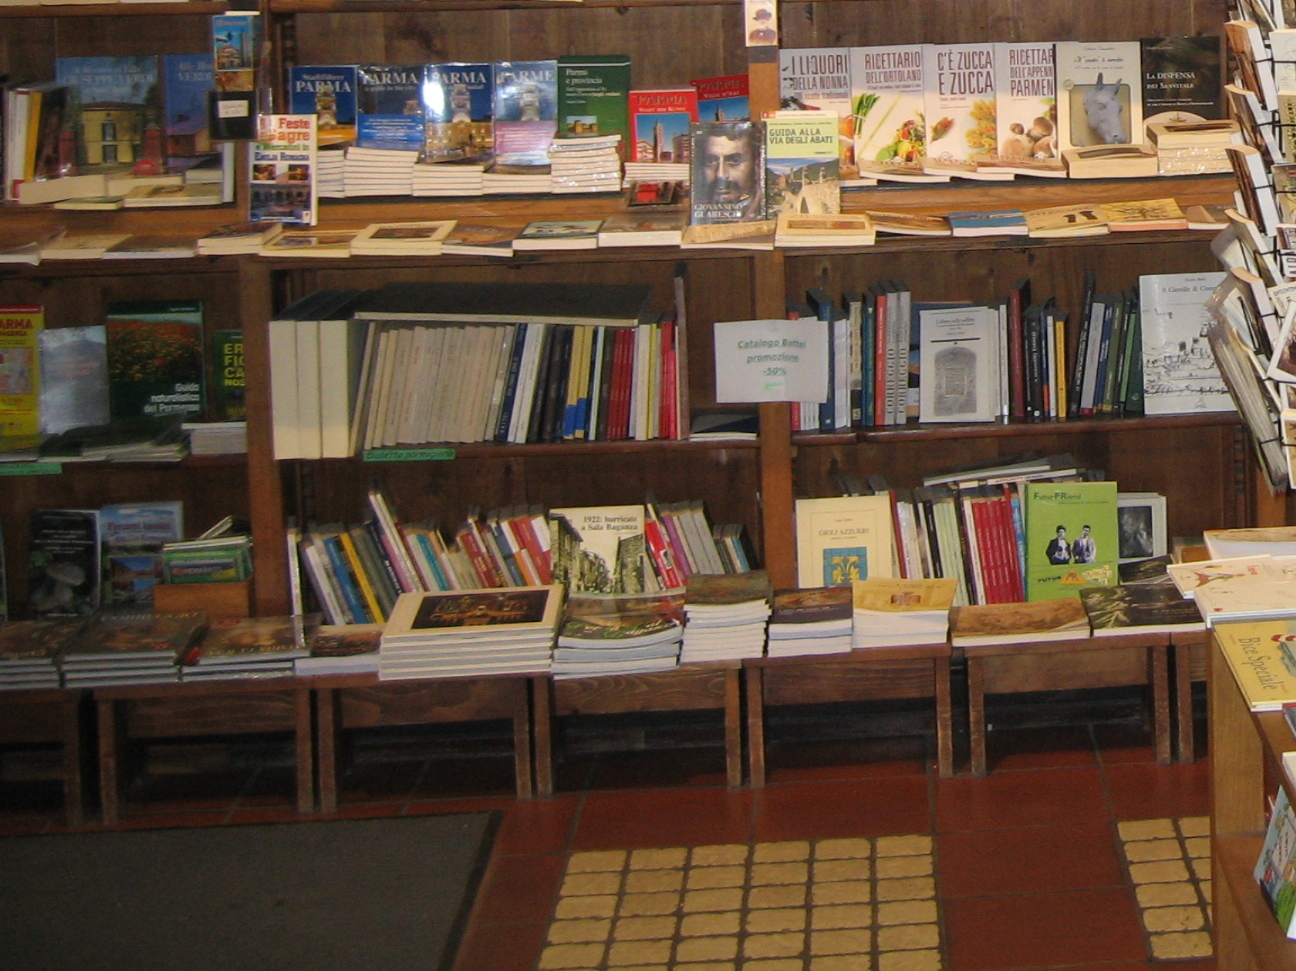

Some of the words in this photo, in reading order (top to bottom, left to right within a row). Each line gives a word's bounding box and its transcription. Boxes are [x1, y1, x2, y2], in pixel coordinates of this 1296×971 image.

[800, 55, 848, 75] LIQUORI
[865, 52, 921, 70] RICETTARIO
[958, 51, 993, 70] ZUCCA
[363, 72, 418, 84] PARMA
[866, 70, 921, 84] DELL'ORTOLANO
[1157, 72, 1196, 80] DISPENSA
[296, 81, 352, 93] PARMA
[820, 77, 848, 90] NONNA
[939, 73, 945, 95] E
[950, 71, 994, 95] ZUCCA
[638, 95, 687, 104] PARMA
[278, 118, 310, 129] Feste
[810, 135, 833, 143] ABATI
[737, 340, 780, 349] Catalogo
[747, 354, 799, 364] promozione
[762, 367, 786, 376] -50%
[898, 348, 907, 414] CORREGGIO
[1238, 637, 1261, 655] Bice
[1241, 655, 1278, 690] Speciale
